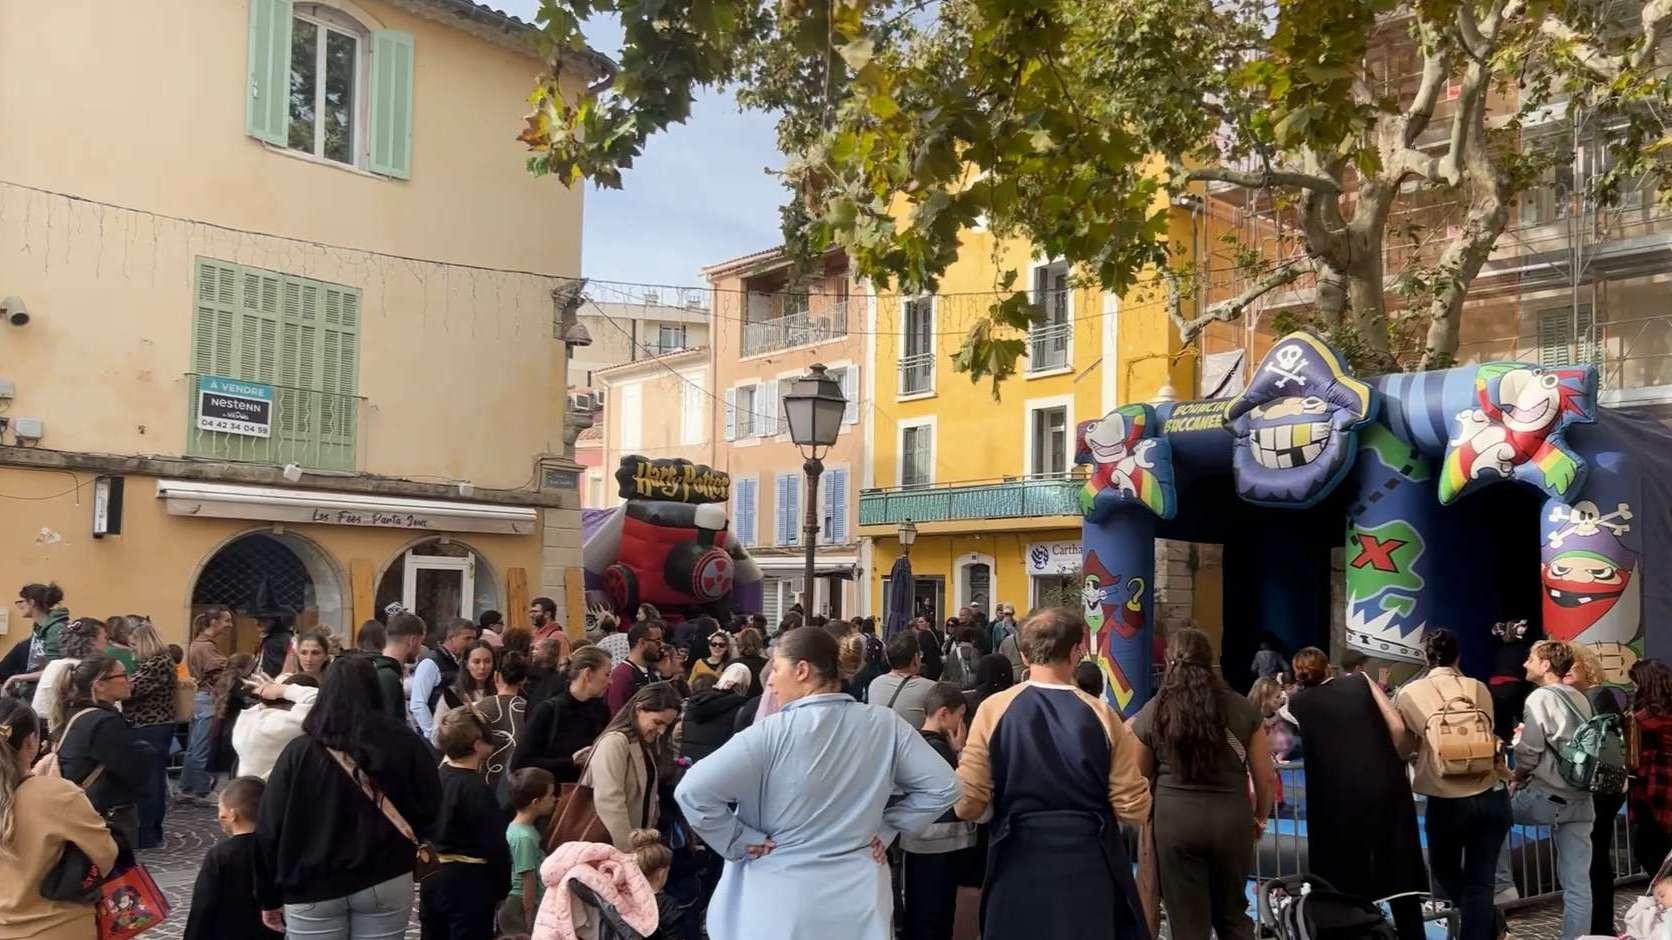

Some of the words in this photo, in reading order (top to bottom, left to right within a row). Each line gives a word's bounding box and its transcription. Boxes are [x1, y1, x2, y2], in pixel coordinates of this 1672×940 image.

[222, 383, 265, 397] VENDRE
[632, 462, 679, 497] Harry
[682, 464, 730, 502] Potter
[312, 506, 329, 521] Les
